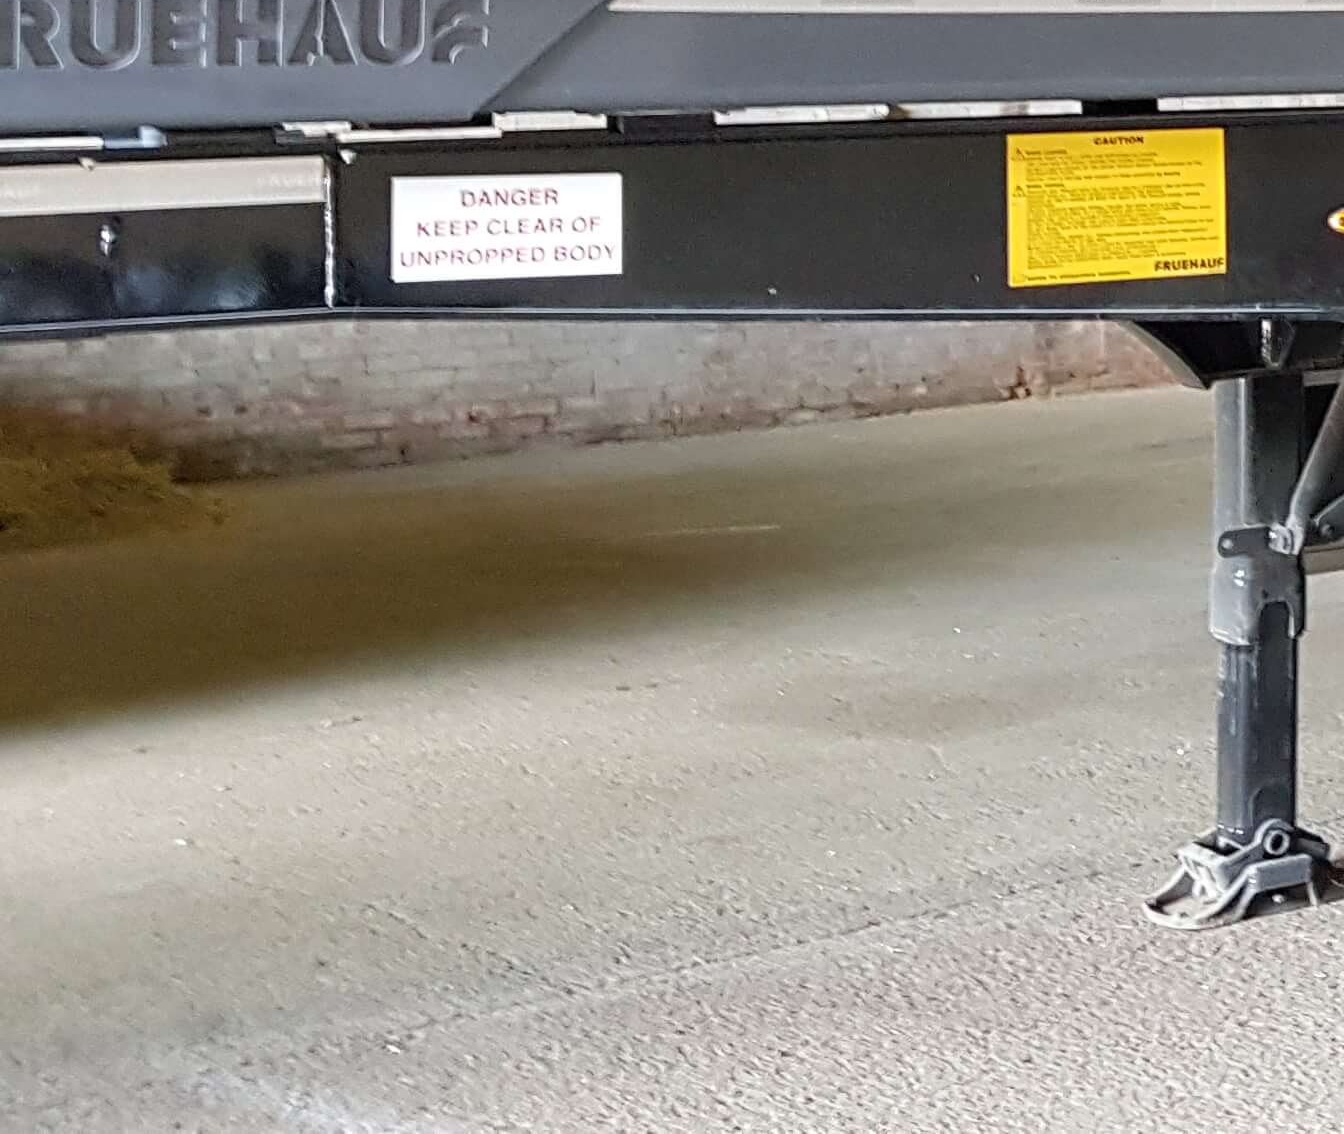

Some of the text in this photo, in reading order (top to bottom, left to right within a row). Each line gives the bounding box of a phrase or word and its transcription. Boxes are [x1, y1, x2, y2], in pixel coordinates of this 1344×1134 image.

[1092, 136, 1145, 146] CAUTION
[459, 188, 559, 208] DANGER
[416, 216, 602, 238] KEEP CLEAR OF
[400, 244, 616, 268] UNPROPPED BODY
[1153, 257, 1225, 272] FRUEHAUF
